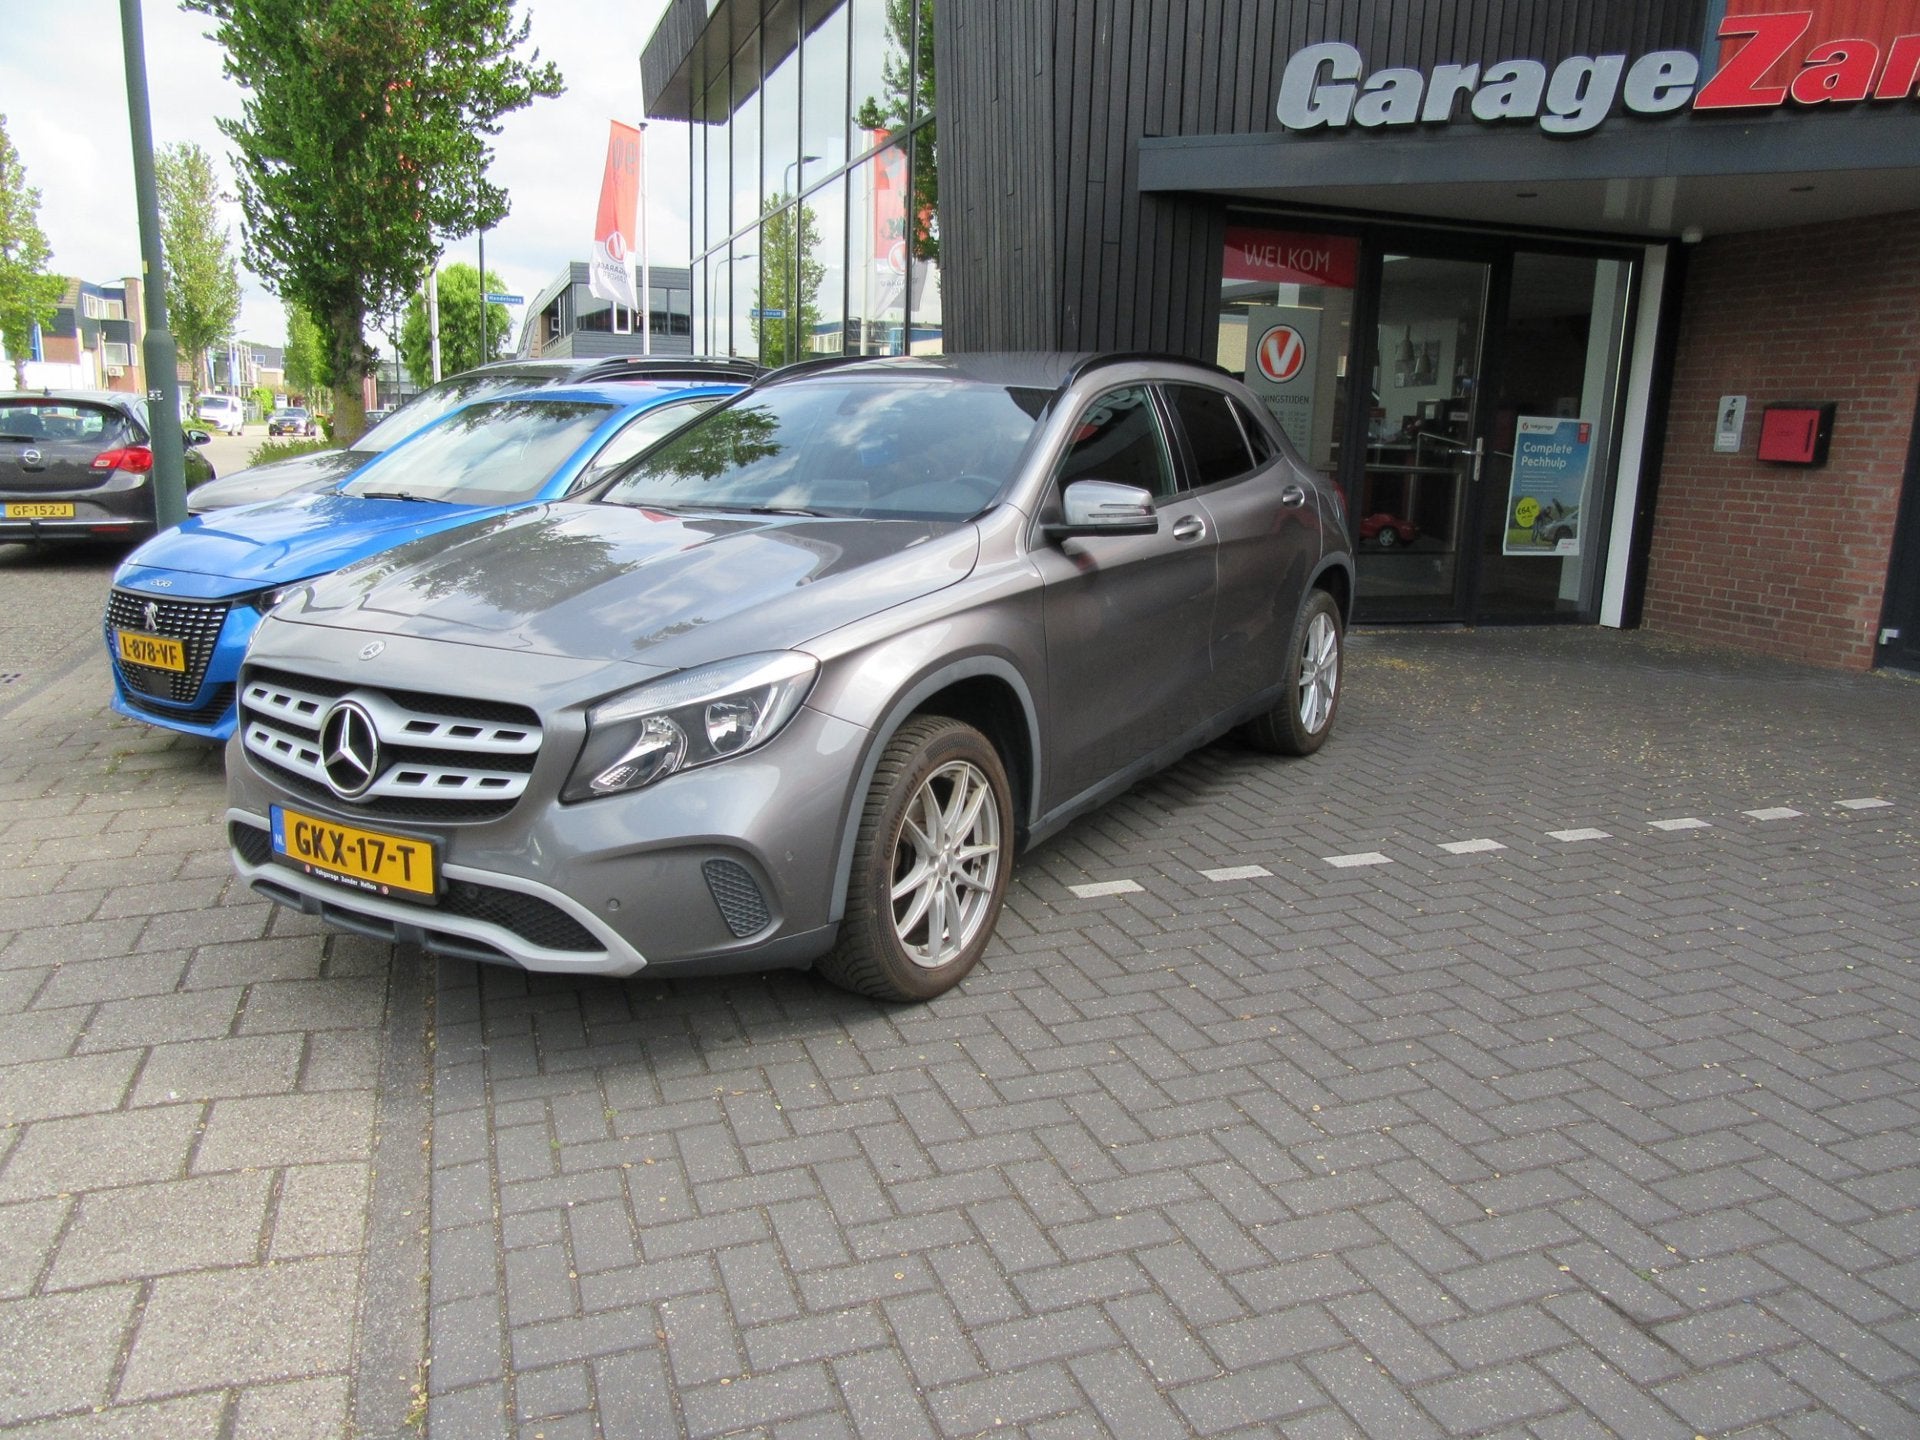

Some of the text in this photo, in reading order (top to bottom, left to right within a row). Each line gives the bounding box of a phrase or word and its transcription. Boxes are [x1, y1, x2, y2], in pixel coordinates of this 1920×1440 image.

[1244, 244, 1330, 272] WELKOM
[1523, 441, 1572, 455] Complete
[1521, 456, 1567, 470] Pechhulp
[12, 505, 67, 516] GF-152-J
[122, 636, 177, 665] L-878-VF
[295, 821, 415, 882] GKX-17-T
